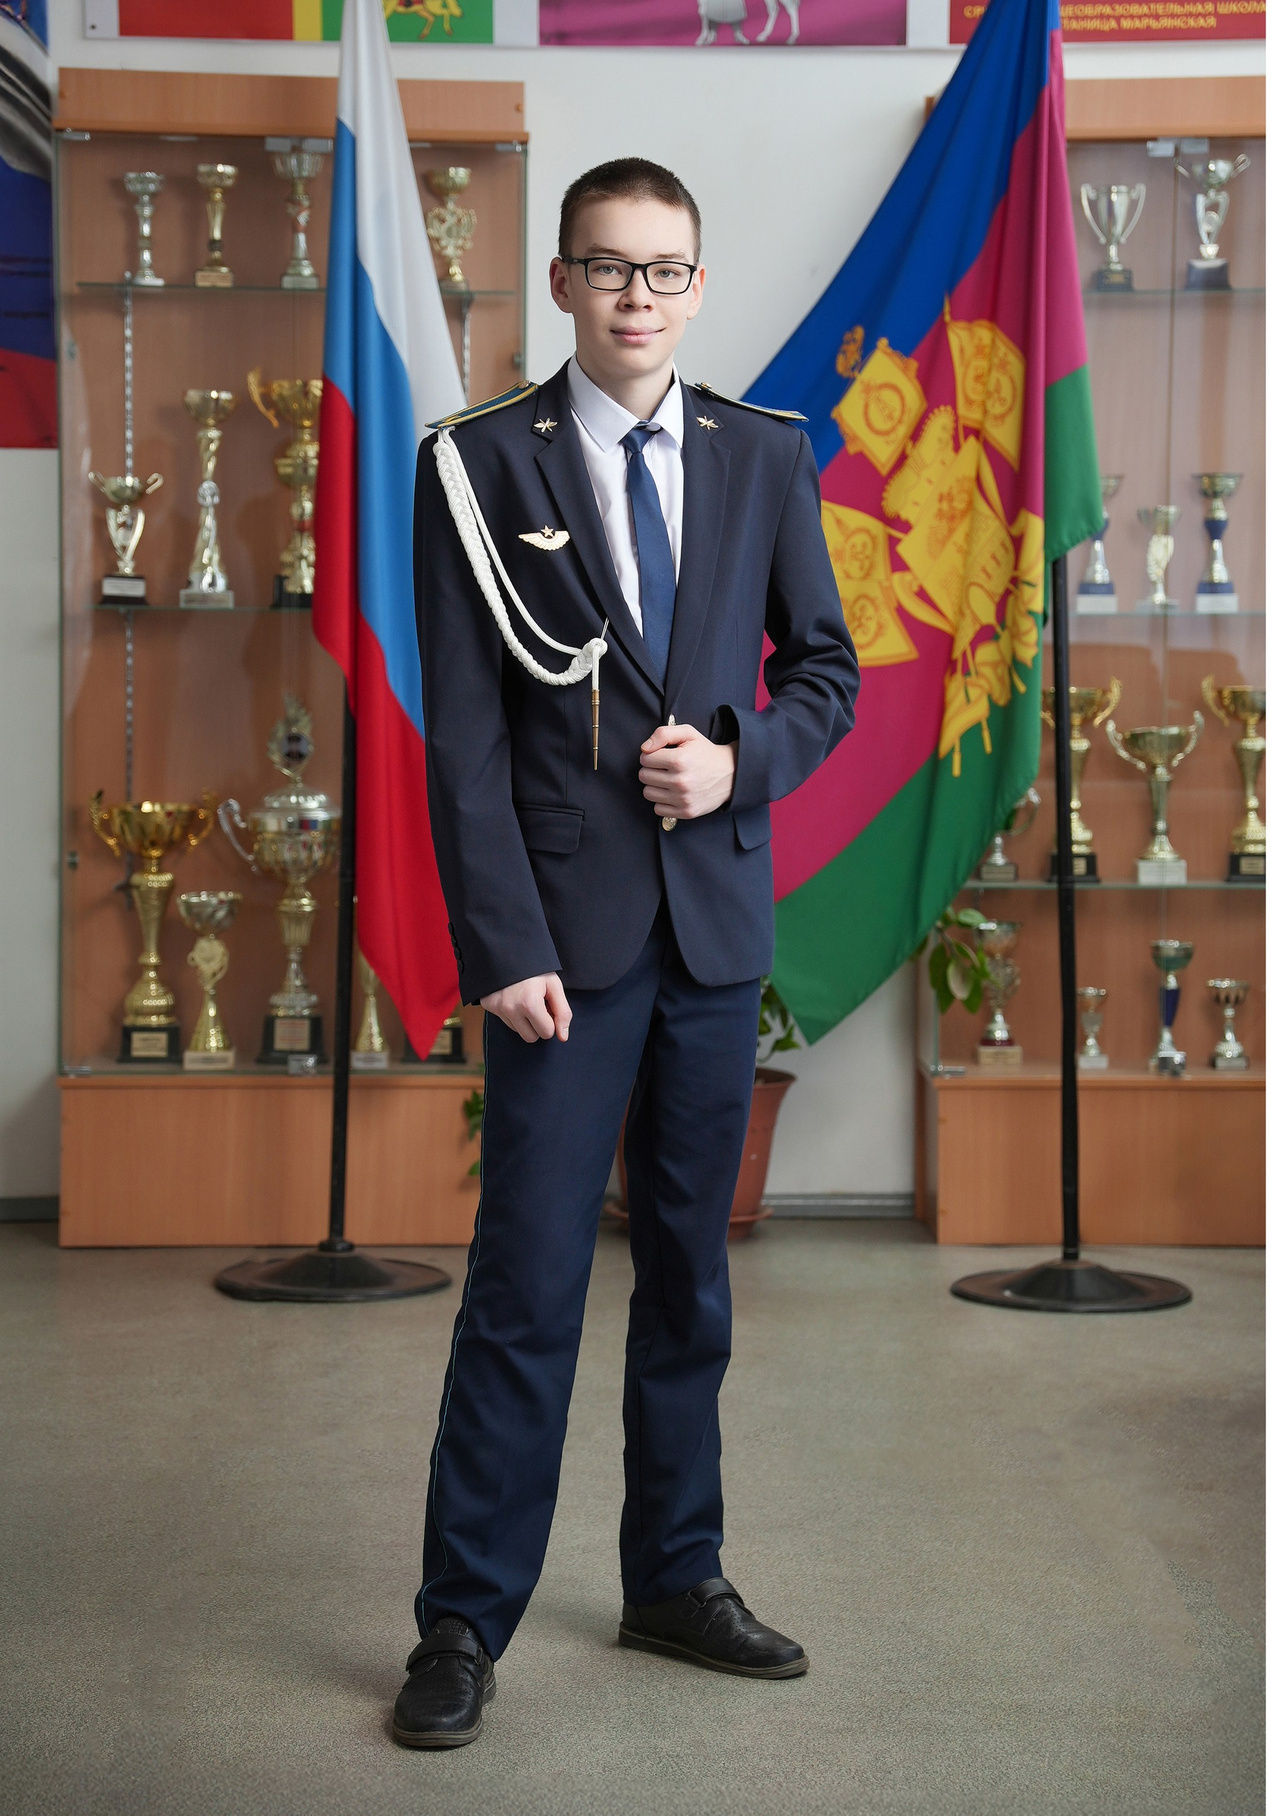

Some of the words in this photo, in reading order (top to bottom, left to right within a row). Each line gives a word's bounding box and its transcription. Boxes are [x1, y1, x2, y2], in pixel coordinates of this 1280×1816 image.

[1061, 2, 1215, 17] ЕОБРАЗОВАТЕЛЬНАЯ
[1217, 1, 1266, 14] ШКОЛА
[1061, 17, 1119, 31] ТАНИЦА
[1121, 16, 1217, 29] МАРЬЯНСКАЯ
